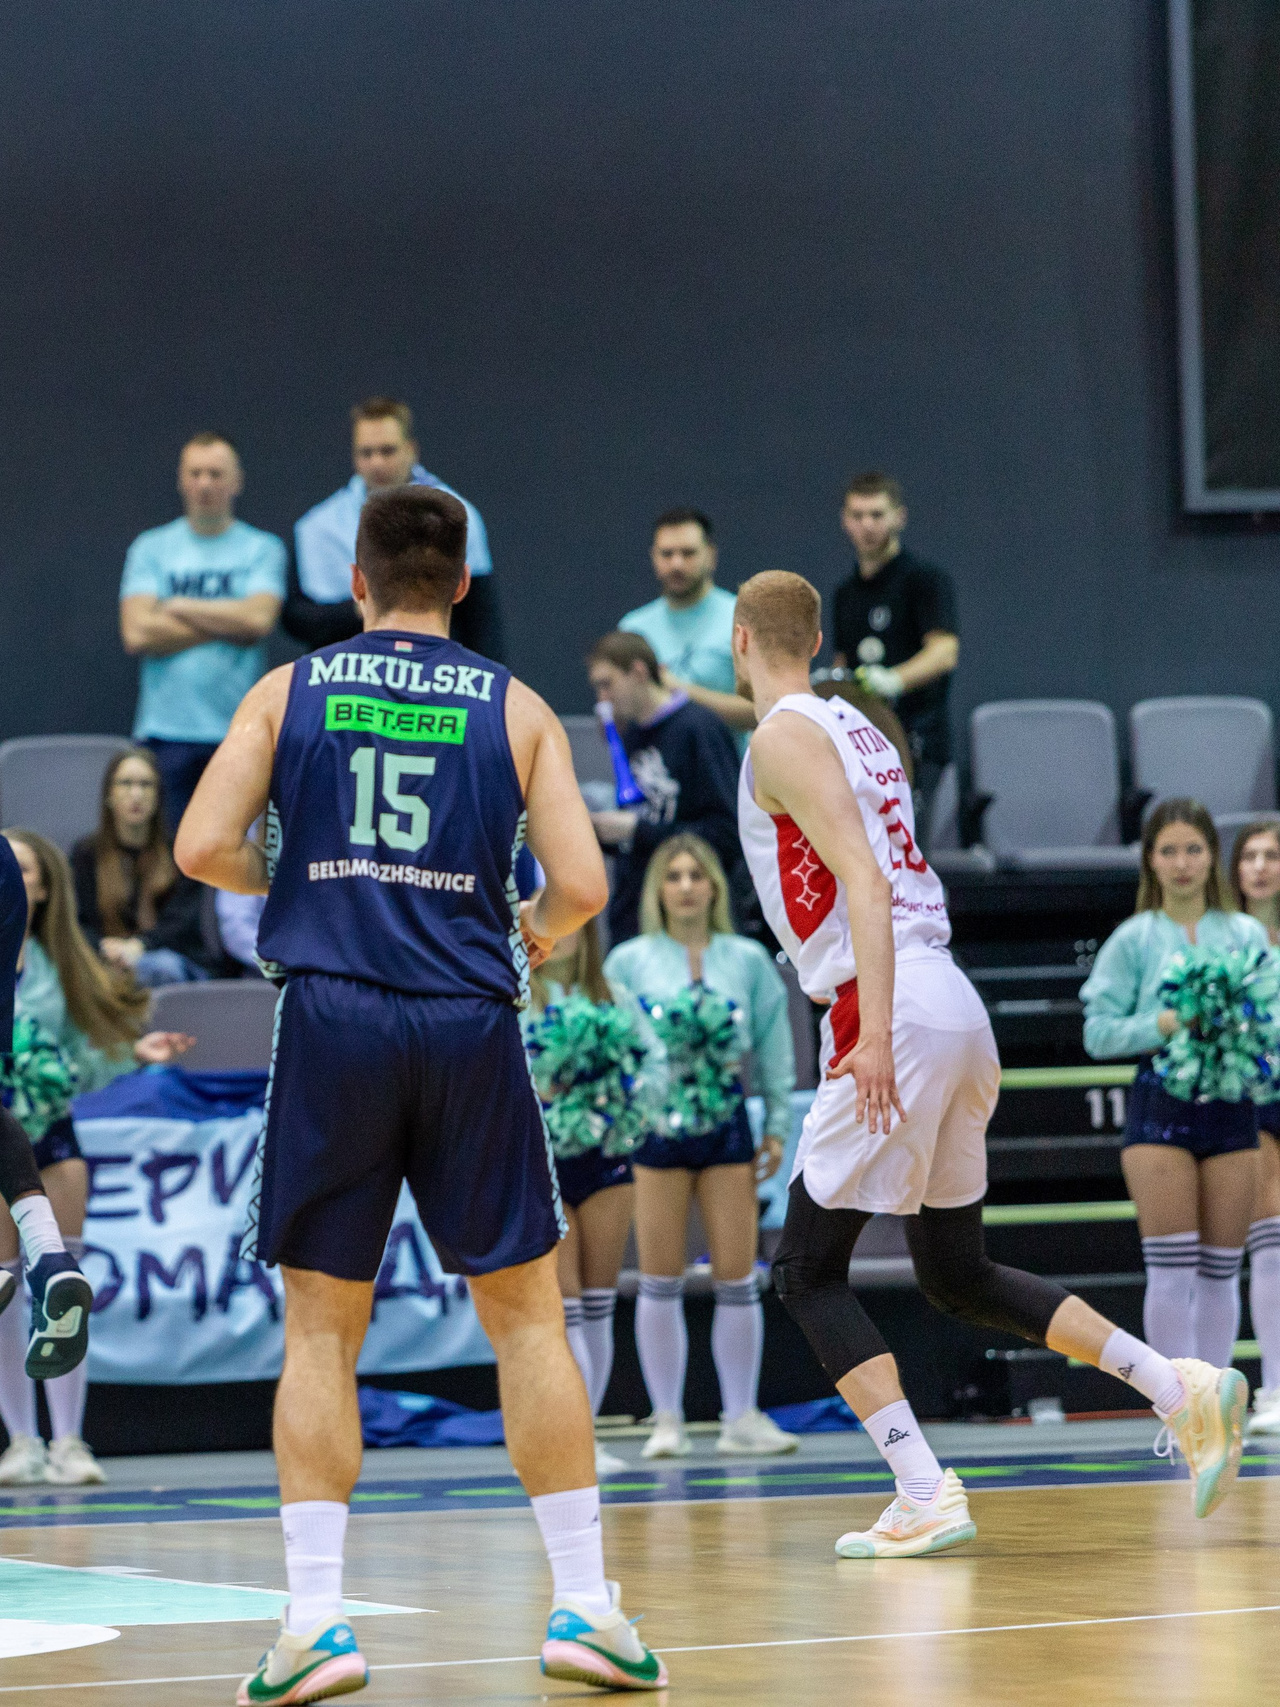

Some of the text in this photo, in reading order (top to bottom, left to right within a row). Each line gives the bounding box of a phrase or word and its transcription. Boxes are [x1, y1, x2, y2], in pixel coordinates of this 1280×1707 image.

[308, 653, 495, 702] MIKULSKI
[336, 703, 458, 735] BETERA
[349, 746, 437, 853] 15
[308, 858, 476, 893] BELTAMOZHSERVICE
[883, 1430, 911, 1448] PEAK
